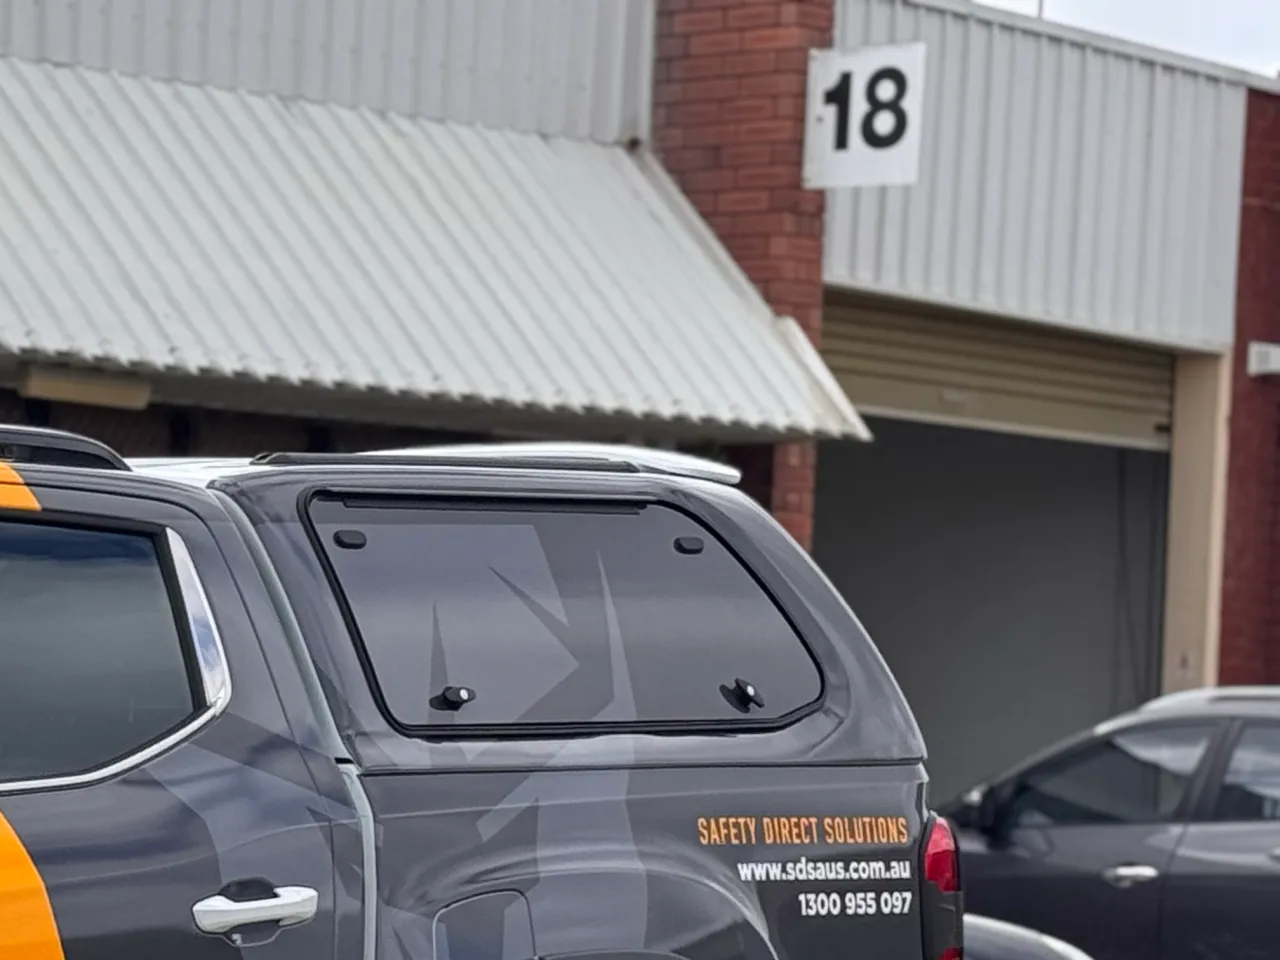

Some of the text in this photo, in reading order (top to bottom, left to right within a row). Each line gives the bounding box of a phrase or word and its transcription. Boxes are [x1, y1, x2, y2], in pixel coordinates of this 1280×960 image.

[824, 66, 908, 151] 18
[697, 816, 908, 845] SAFETY DIRECT SOLUTIONS
[737, 857, 911, 881] www.sdsaus.com.au
[798, 891, 912, 916] 1300 955 097
